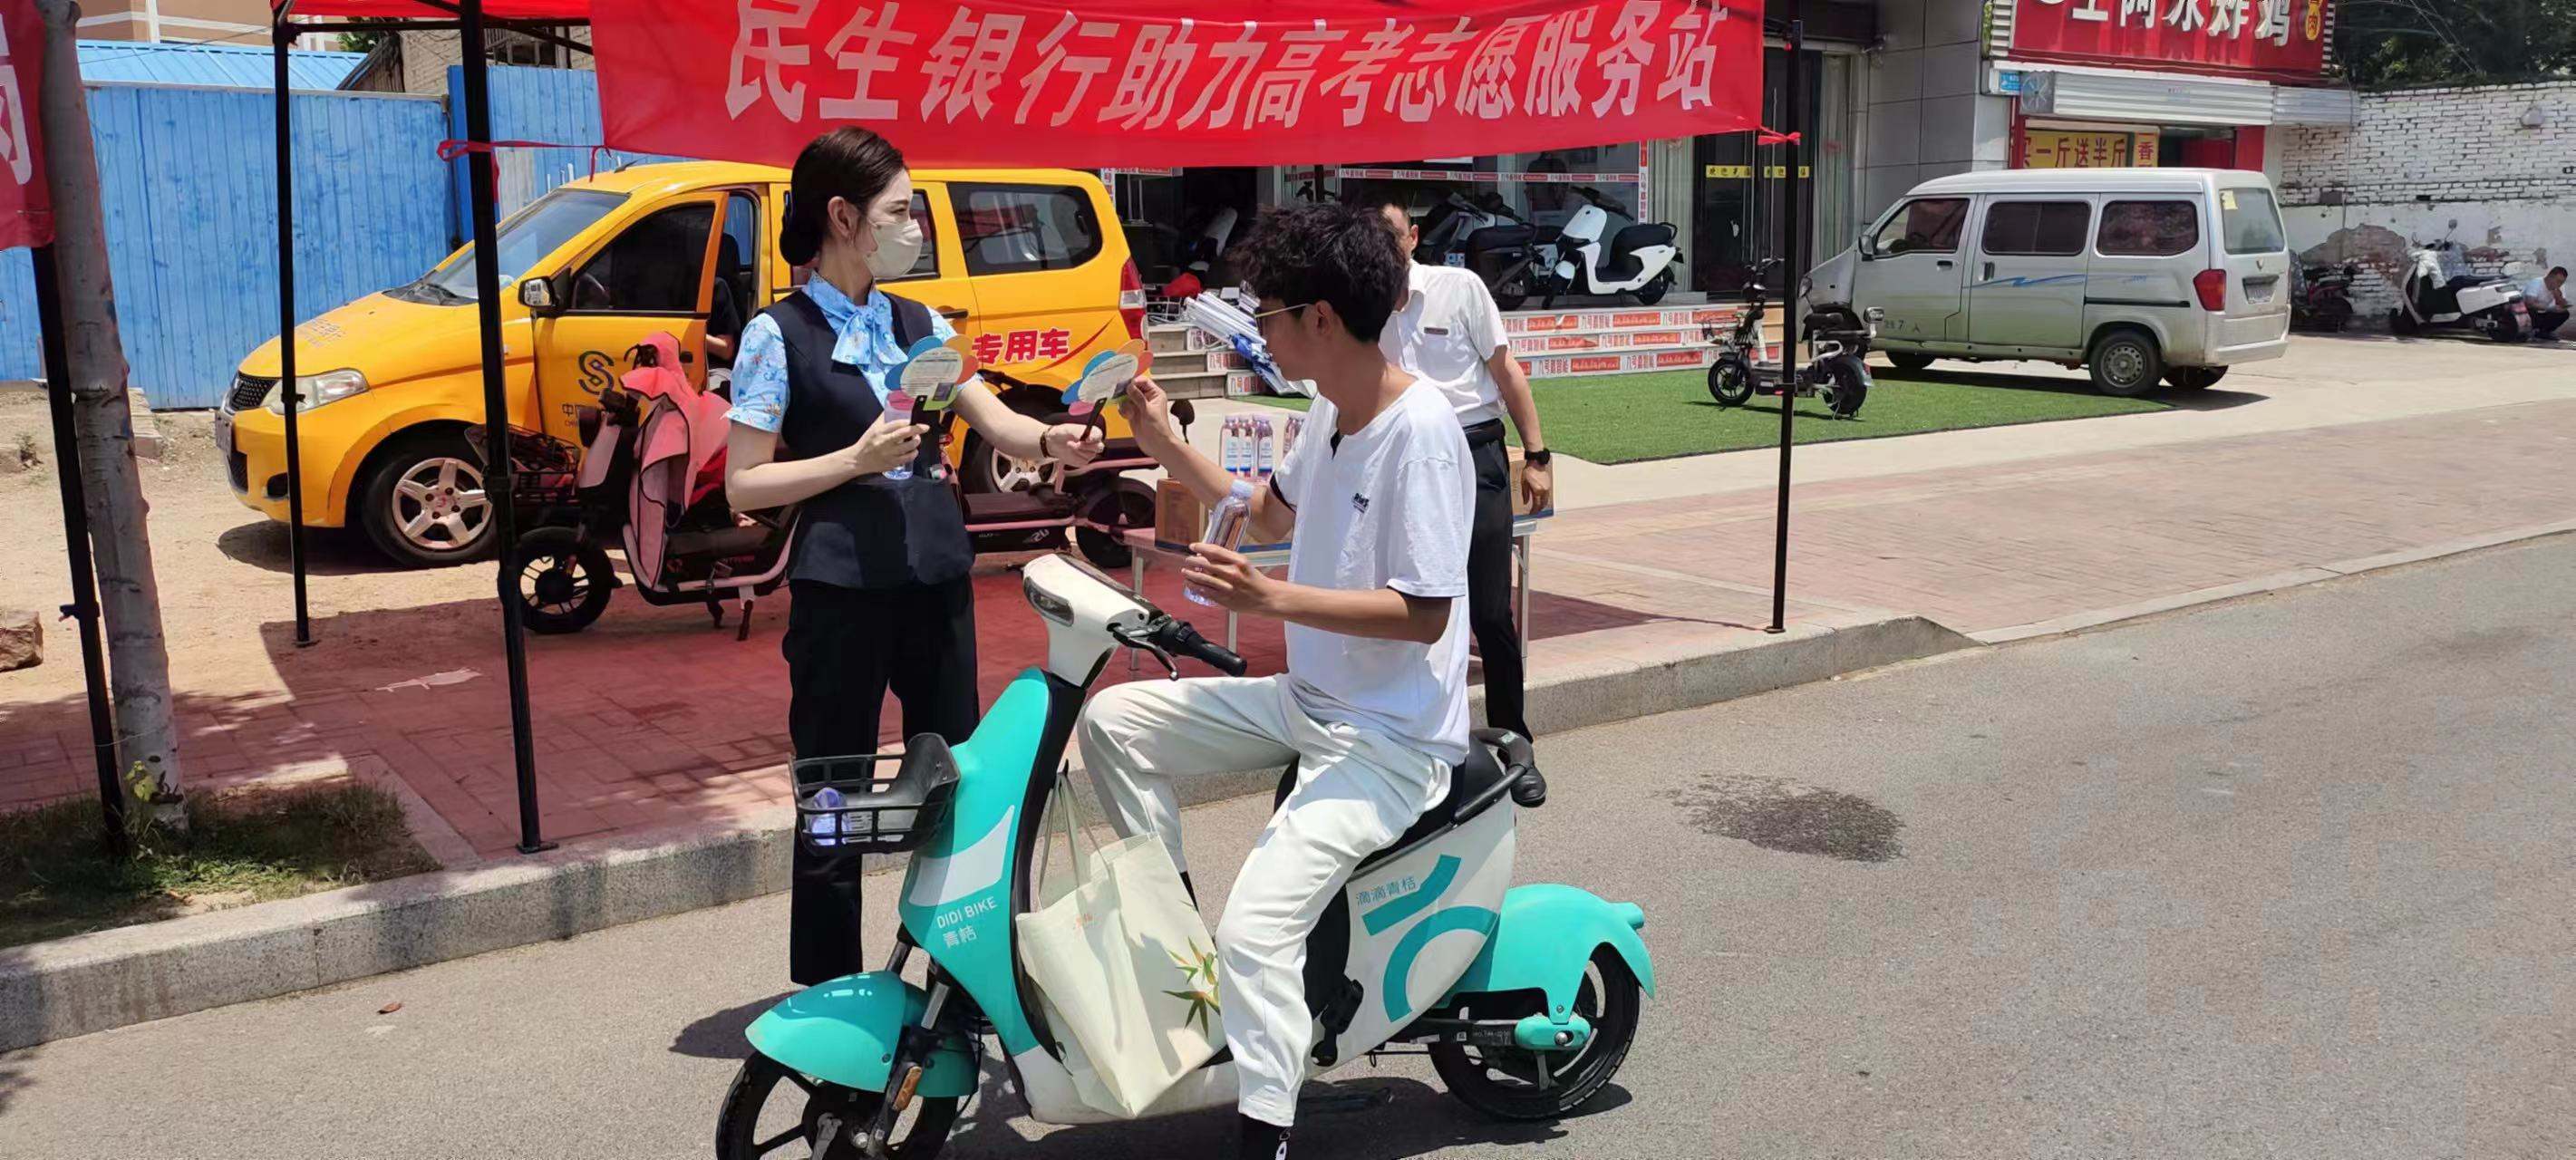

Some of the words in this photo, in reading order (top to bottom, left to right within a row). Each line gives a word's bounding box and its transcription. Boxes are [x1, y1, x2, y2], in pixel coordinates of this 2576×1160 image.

[724, 0, 1727, 131] 民生银行助力高考志愿服务站
[971, 328, 1070, 364] 专用车
[1355, 875, 1416, 905] 滴滴青桔
[936, 908, 963, 929] DIDI
[964, 896, 998, 918] BIKE
[943, 924, 977, 949] 青桔
